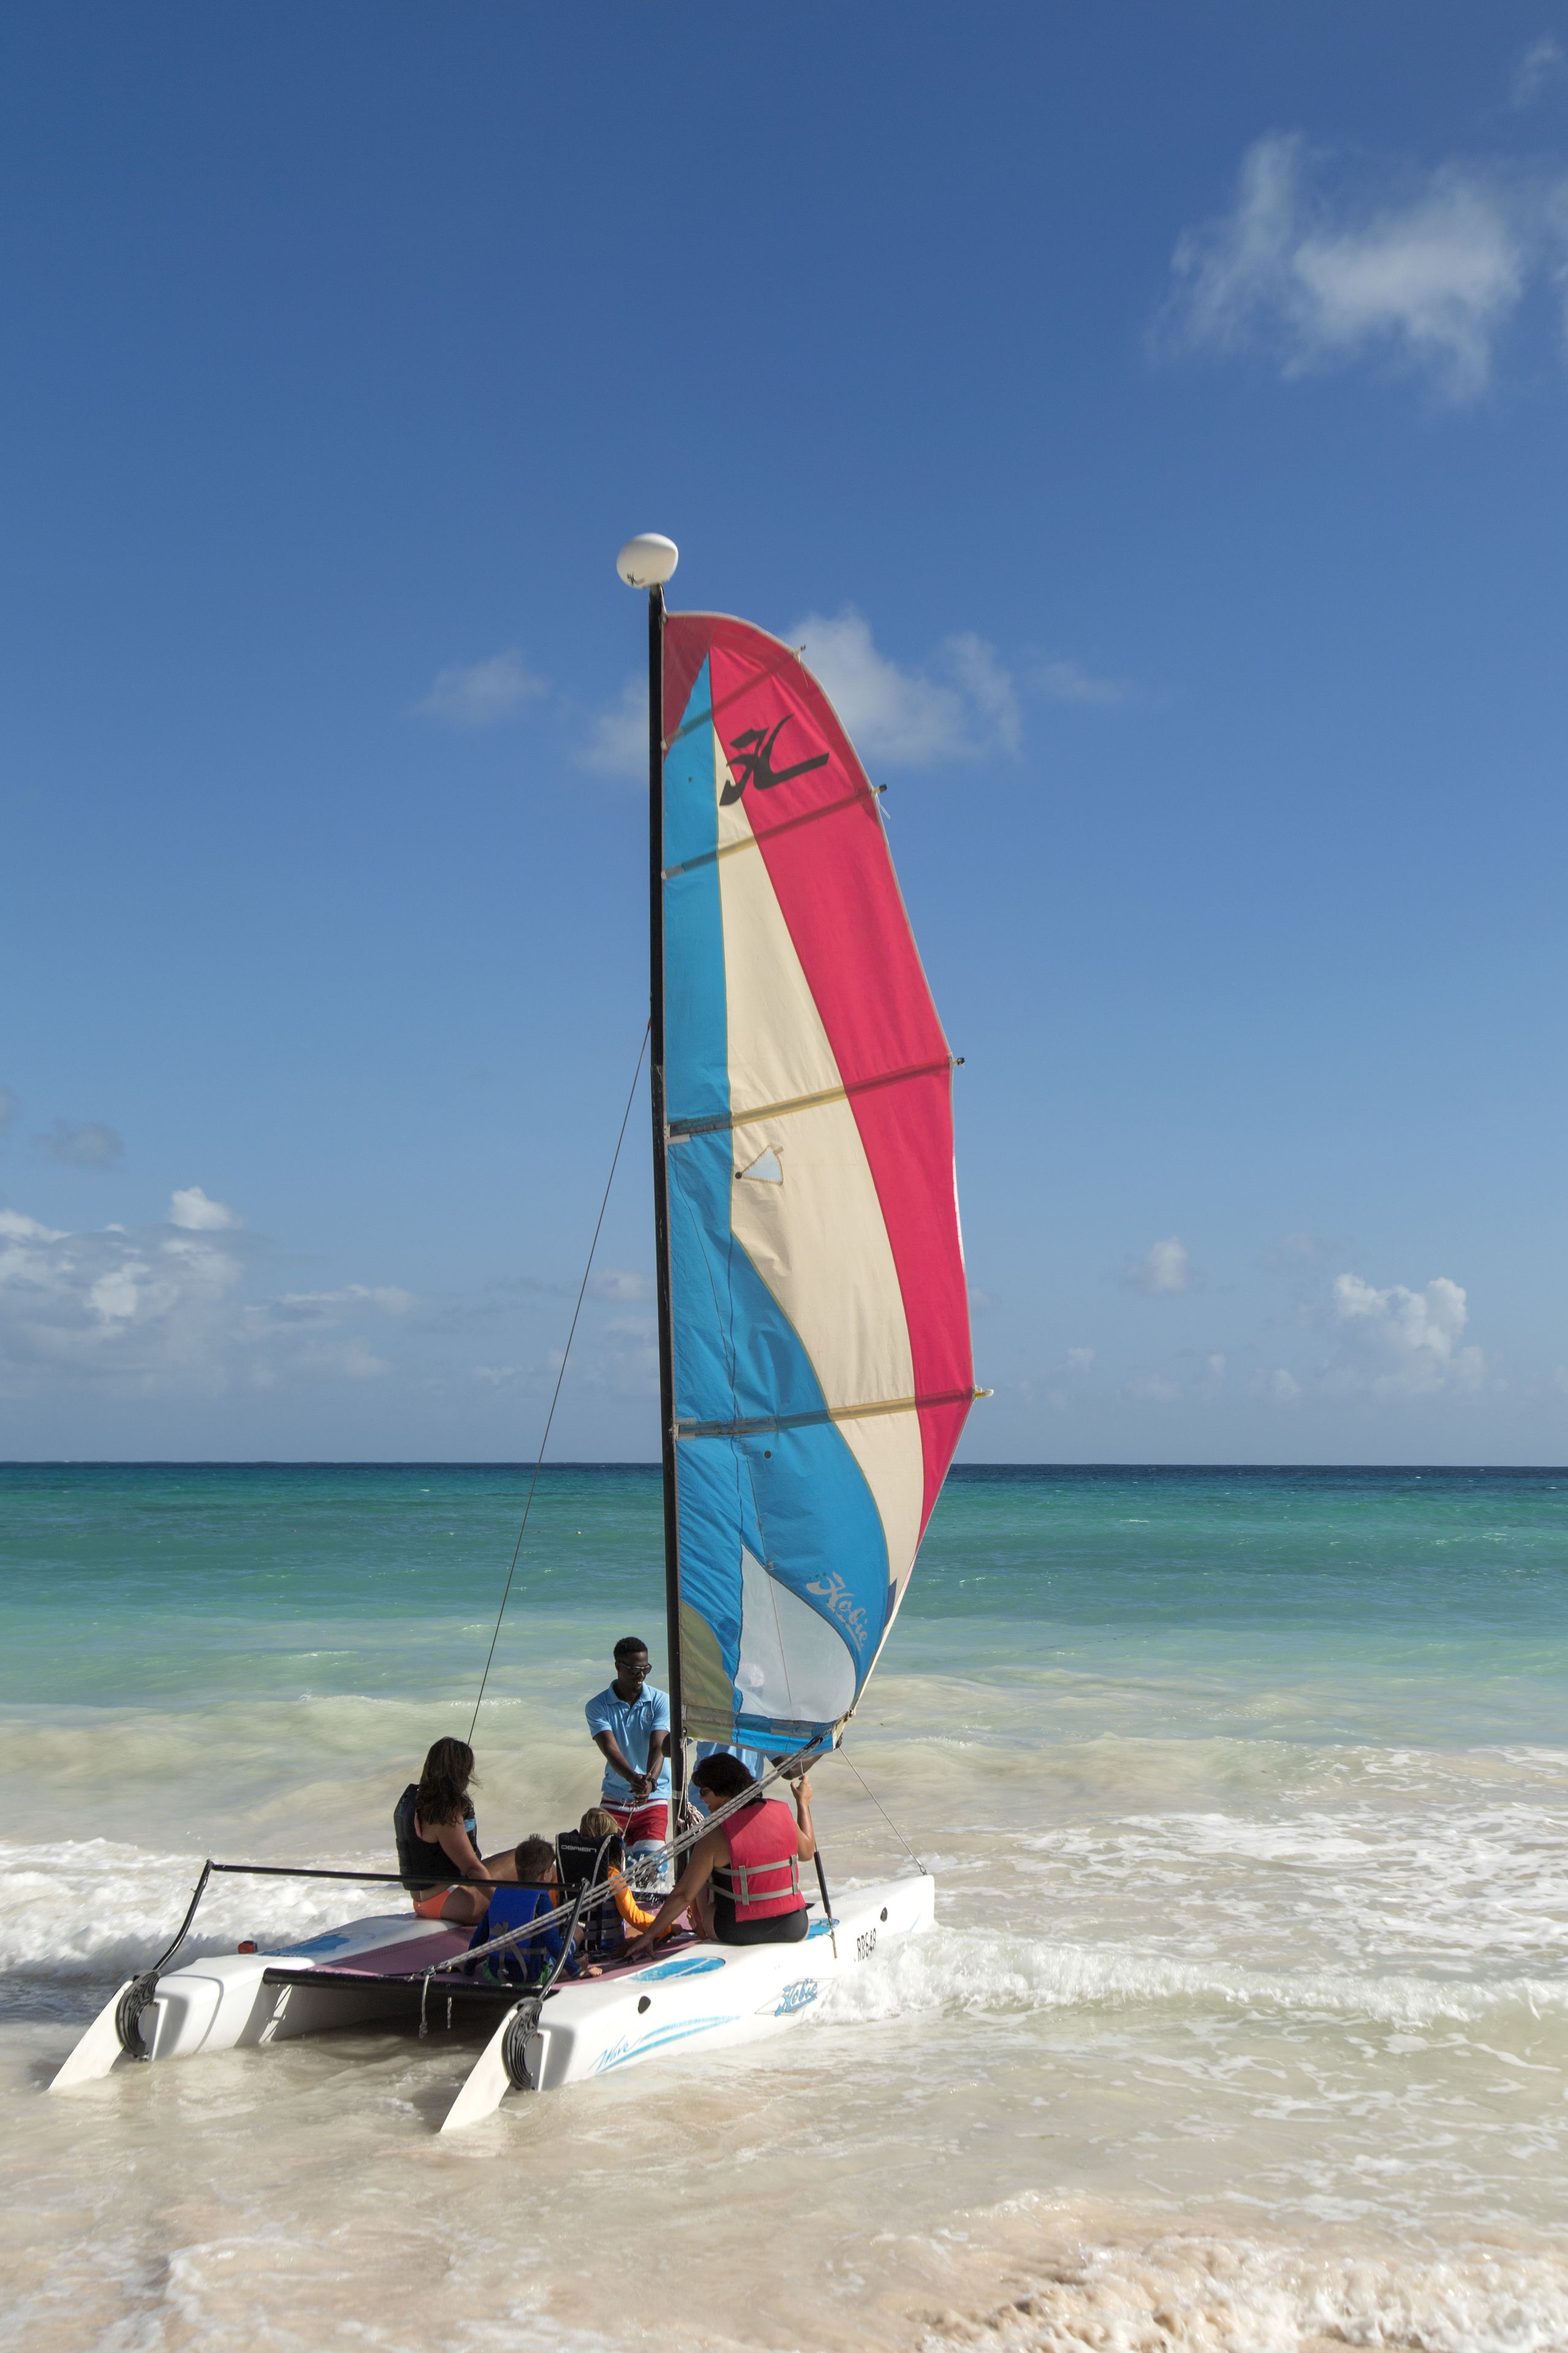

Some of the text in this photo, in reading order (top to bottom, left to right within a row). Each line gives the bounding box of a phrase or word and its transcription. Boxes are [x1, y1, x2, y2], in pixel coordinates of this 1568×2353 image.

[806, 1571, 868, 1653] Hobie
[775, 1977, 818, 2017] Hobie
[588, 2034, 635, 2075] Wave
